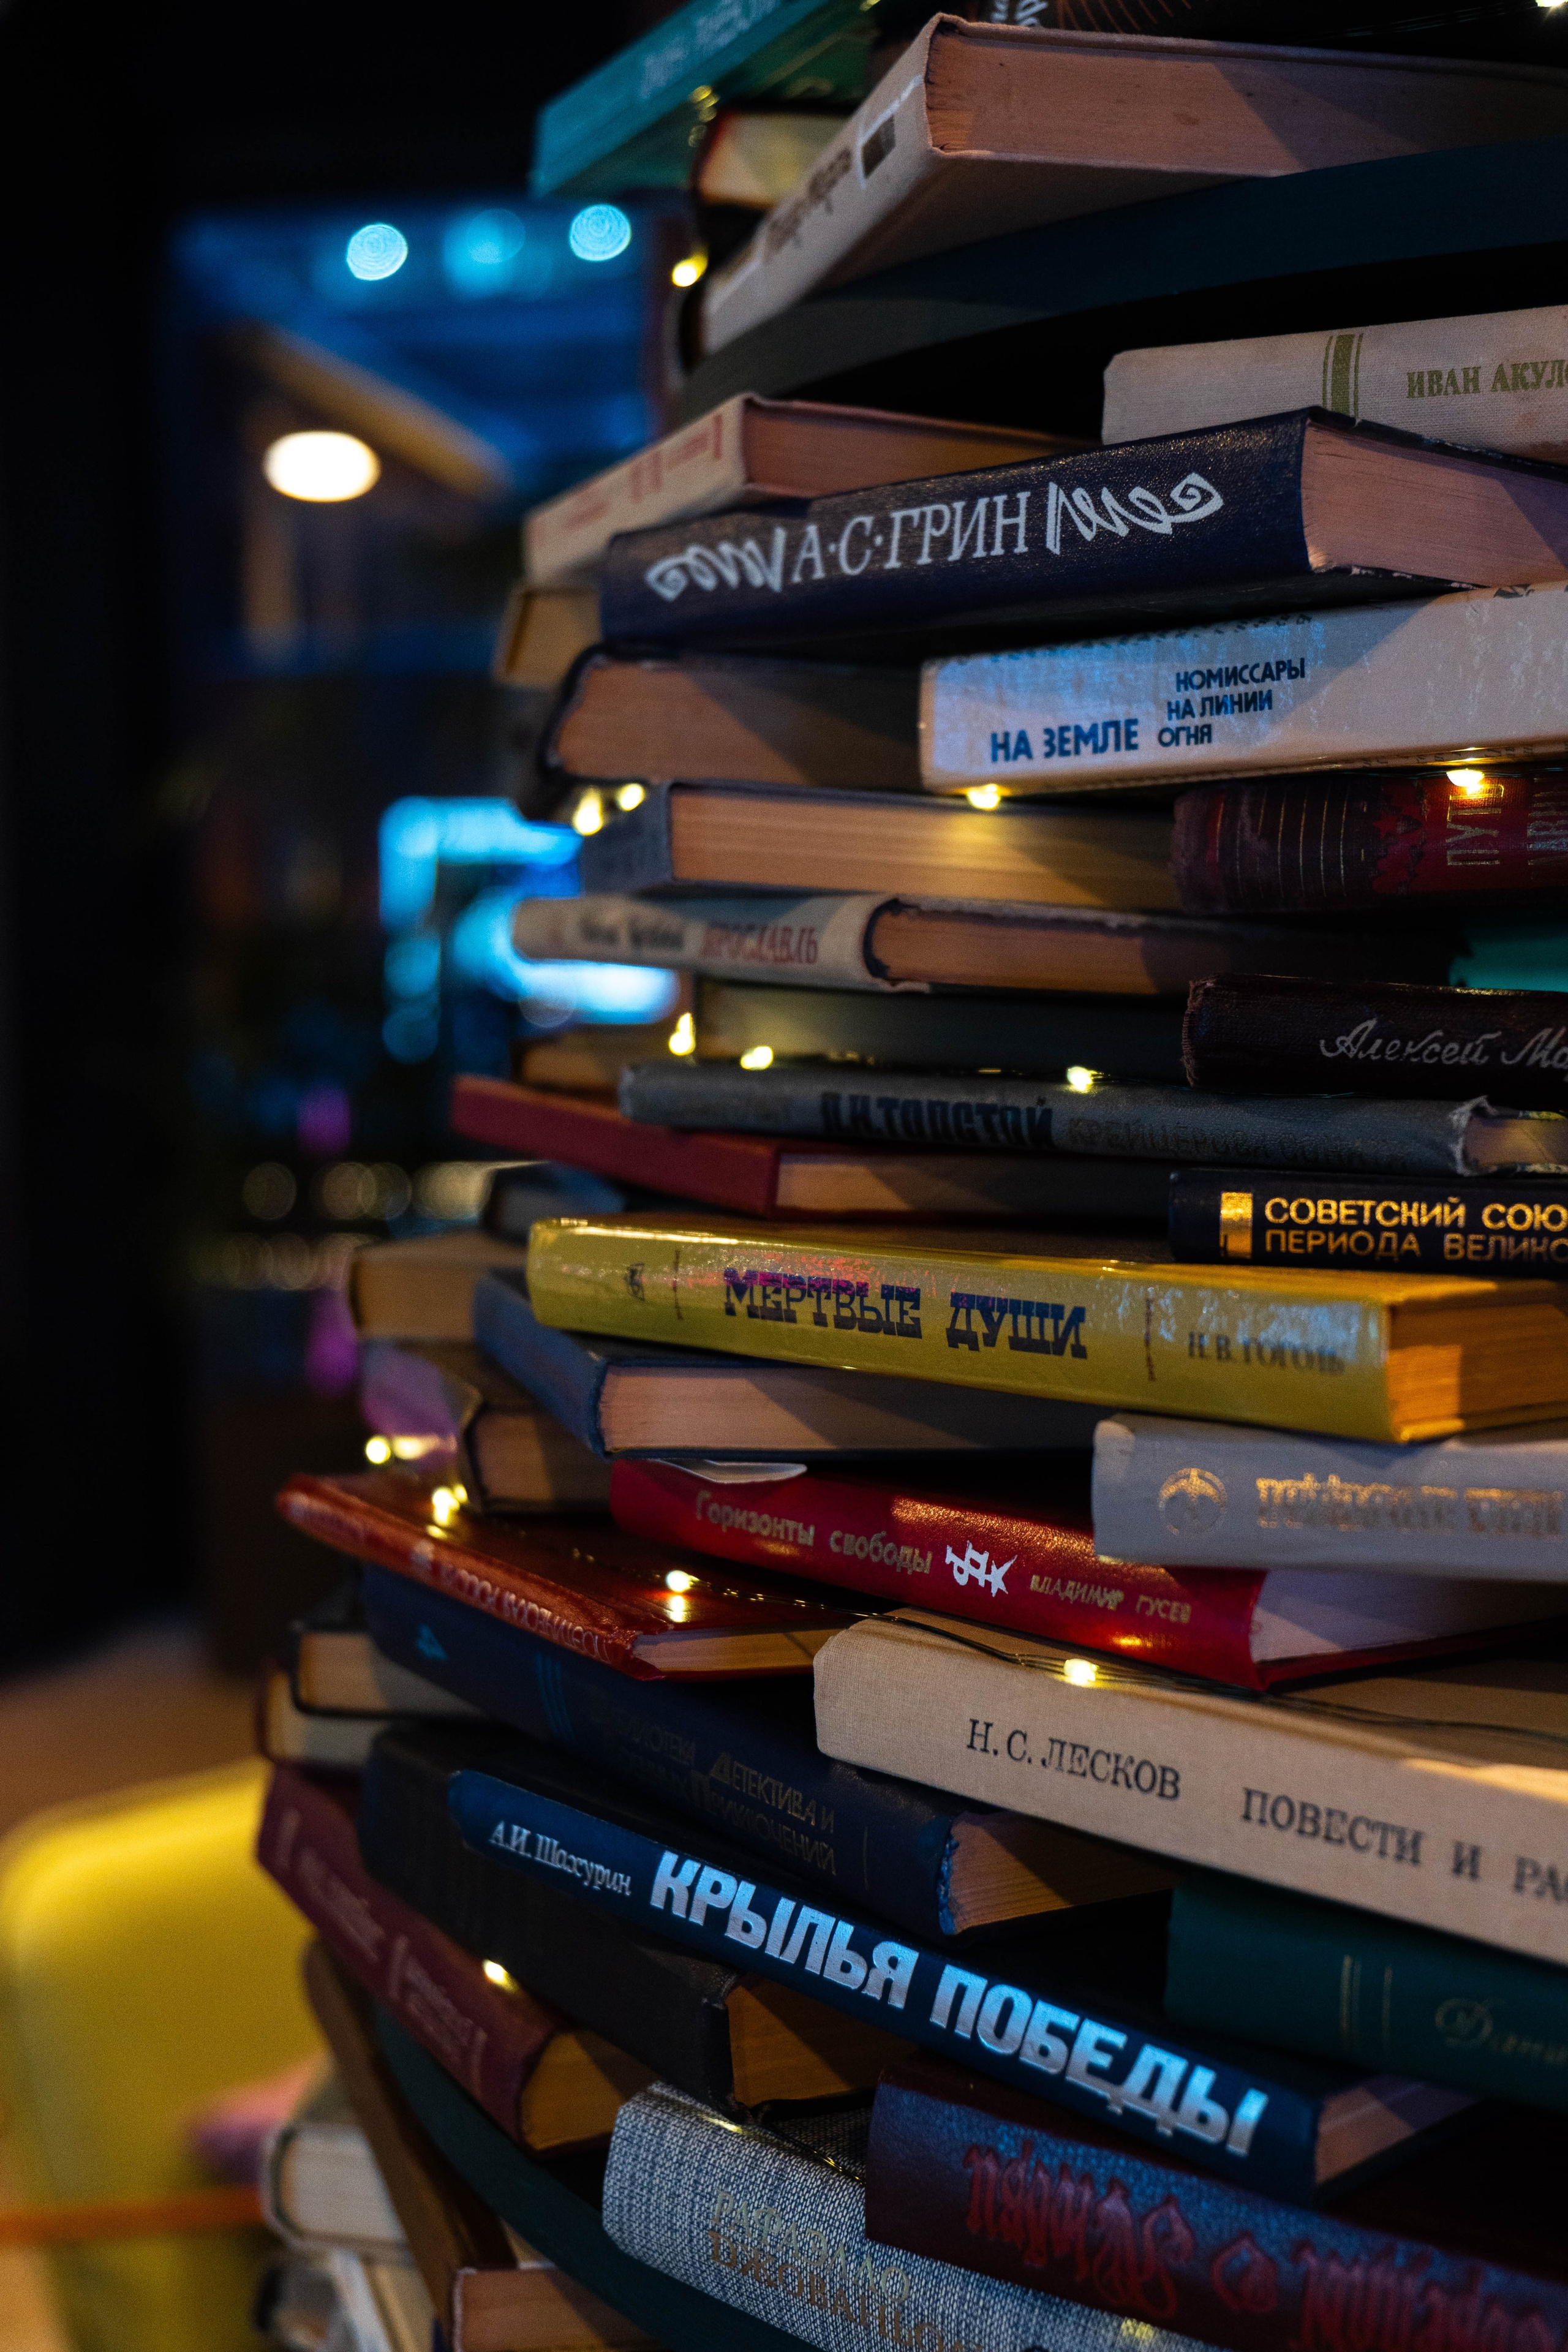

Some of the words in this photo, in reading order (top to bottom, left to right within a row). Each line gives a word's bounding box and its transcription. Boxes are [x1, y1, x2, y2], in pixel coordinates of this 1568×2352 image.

[1406, 367, 1481, 399] ИВАН
[1175, 657, 1306, 693] КОМИССАРЫ
[1167, 699, 1196, 722] НА
[1199, 689, 1273, 718] ЛИНИИ
[990, 730, 1033, 763] НА
[1044, 718, 1139, 759] ЗЕМЛЕ
[1158, 724, 1212, 748] ОГНЯ
[1319, 1017, 1502, 1066] Алексей
[1264, 1196, 1466, 1228] СОВЕТСКИЙ
[1265, 1229, 1422, 1262] ПЕРИОДА
[723, 1268, 922, 1339] МЕРТВЫЕ
[946, 1292, 1087, 1359] ДУШИ
[696, 1490, 816, 1547] Горизонты
[829, 1530, 933, 1575] свободы
[1136, 1594, 1191, 1624] ГУСЕВ
[1242, 1787, 1427, 1868] ПОВЕСТИ
[1453, 1840, 1482, 1882] И
[1513, 1855, 1568, 1902] РА
[650, 1851, 919, 2010] КРЫЛЬЯ
[929, 1964, 1268, 2157] ПОБЕДЫ
[712, 2189, 910, 2305] РАФАЭЛЛО
[707, 2230, 983, 2352] ДЖОВАНЬО
